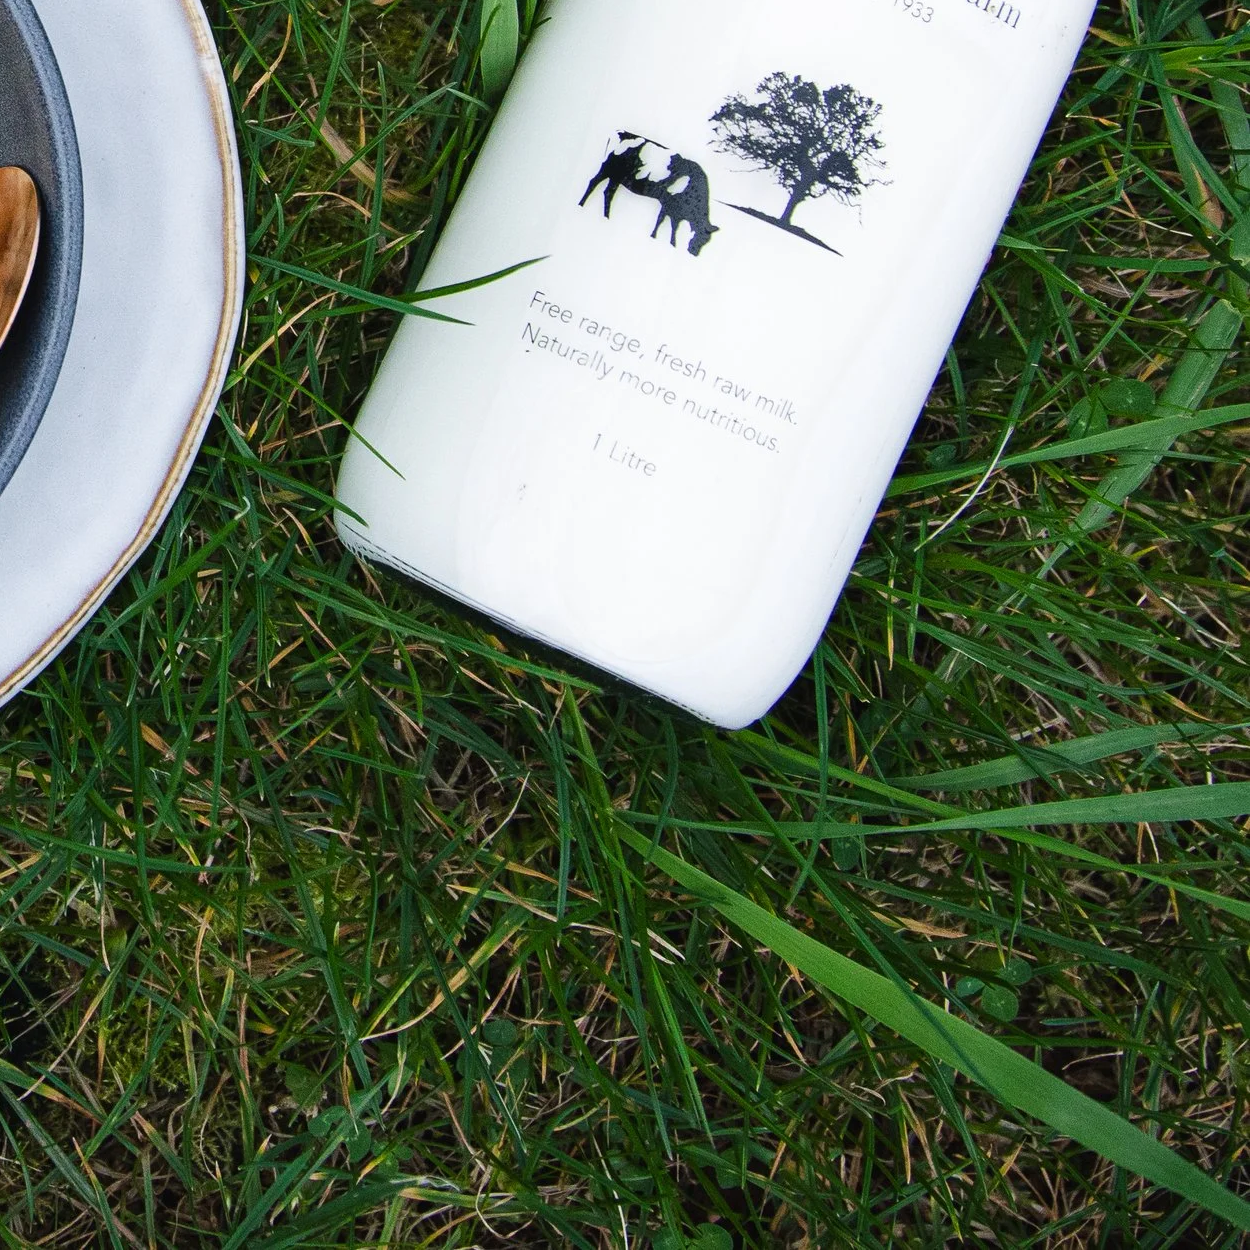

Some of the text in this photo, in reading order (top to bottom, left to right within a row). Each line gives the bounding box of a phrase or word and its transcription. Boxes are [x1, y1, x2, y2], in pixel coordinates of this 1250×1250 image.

[521, 322, 780, 453] Naturally more nutritious.
[529, 290, 798, 425] Free range, fresh raw milk.
[593, 433, 657, 477] 1 Litre
